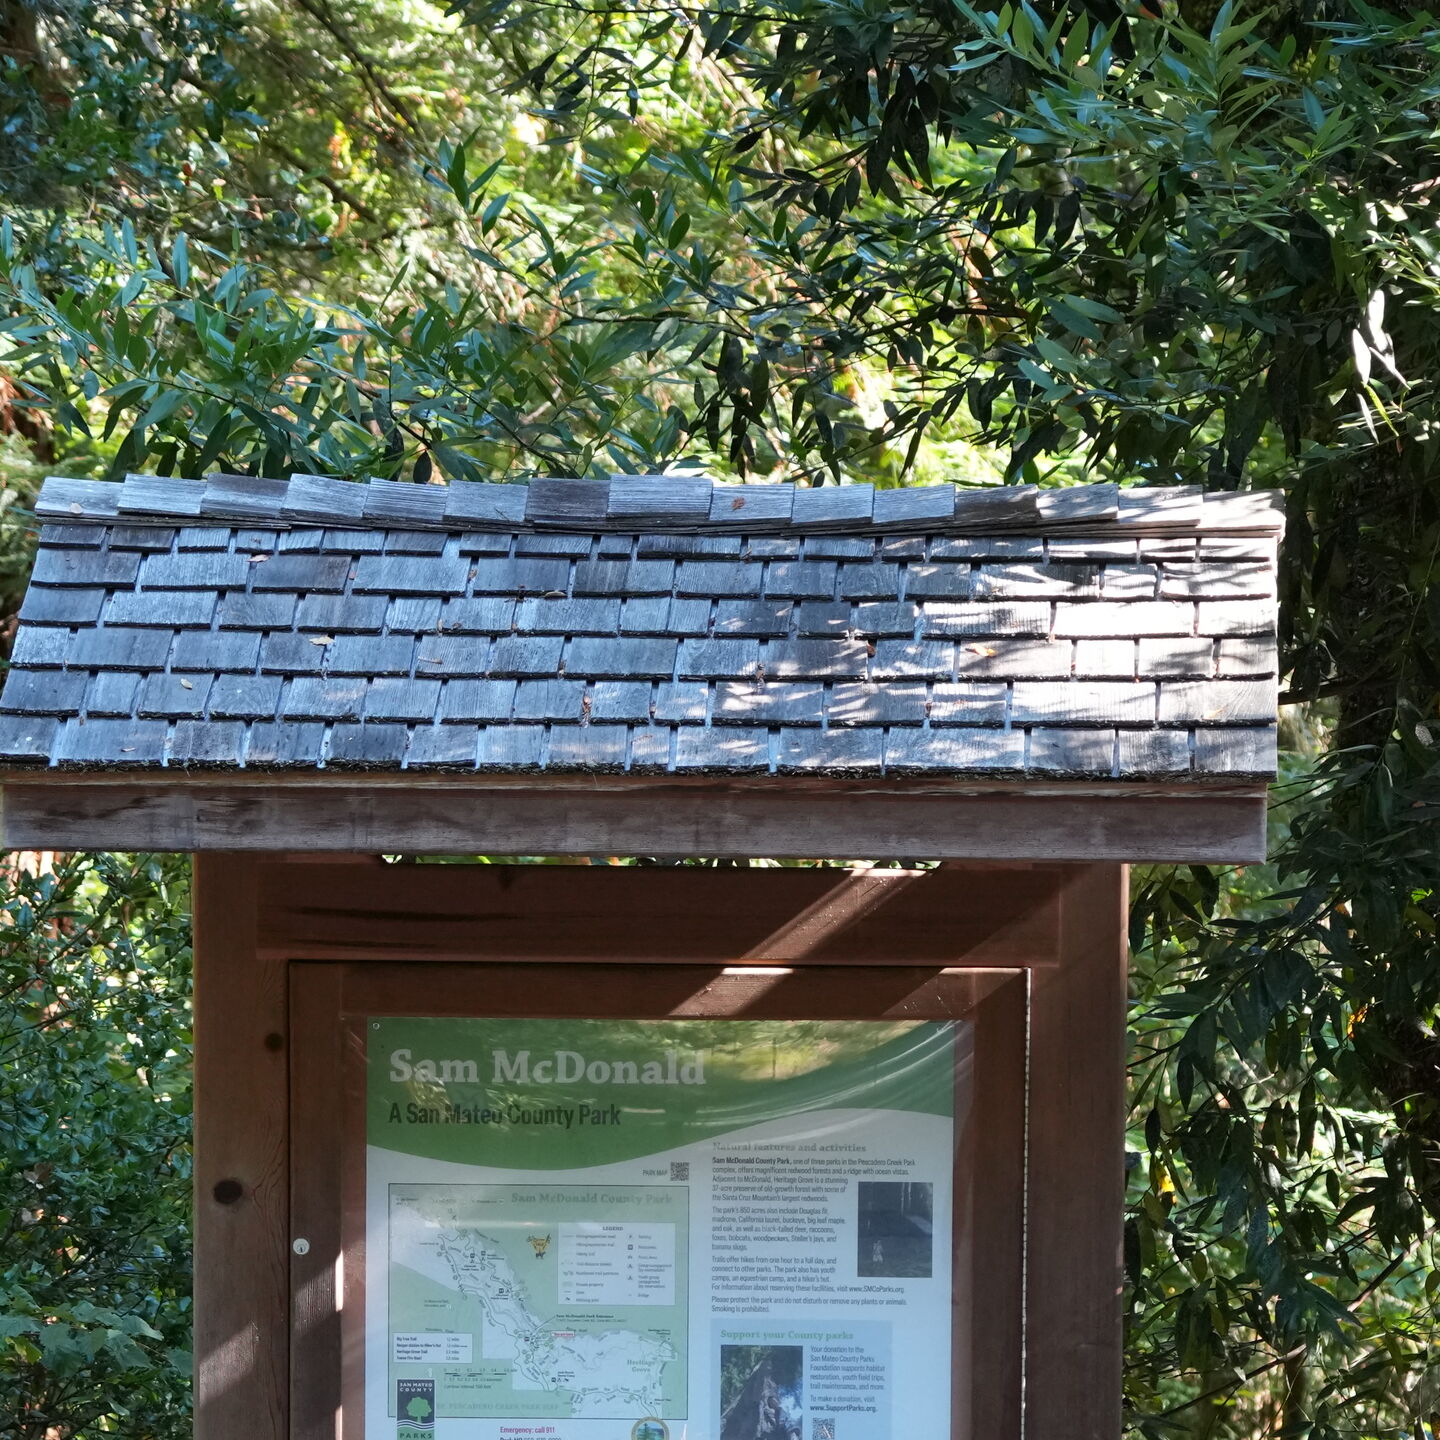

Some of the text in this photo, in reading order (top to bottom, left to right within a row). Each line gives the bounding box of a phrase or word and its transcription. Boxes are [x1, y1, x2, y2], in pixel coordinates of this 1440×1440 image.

[389, 1048, 707, 1085] Sam McDonald
[388, 1102, 621, 1130] A San Mateo County Park
[797, 1144, 818, 1152] and
[819, 1144, 867, 1152] activities
[712, 1156, 725, 1164] Sam
[755, 1157, 776, 1166] County
[825, 1158, 841, 1167] parks
[754, 1166, 787, 1175] magnificent
[847, 1167, 861, 1176] ridge
[712, 1175, 736, 1184] Adjacent
[773, 1176, 796, 1185] Heritage
[824, 1177, 848, 1185] stunning
[511, 1192, 536, 1204] Sam
[540, 1192, 598, 1204] McDonald
[601, 1193, 642, 1205] County
[645, 1193, 672, 1205] Park
[781, 1194, 800, 1203] largest
[798, 1207, 821, 1216] Douglas
[740, 1265, 755, 1273] other
[784, 1266, 797, 1275] park
[820, 1266, 836, 1275] youth
[739, 1275, 768, 1283] equestrian
[721, 1283, 752, 1291] information
[769, 1284, 795, 1293] reserving
[729, 1296, 750, 1305] protect
[760, 1296, 772, 1305] park
[860, 1297, 877, 1306] plants
[712, 1305, 735, 1314] Smoking
[720, 1329, 854, 1341] Support your County parks
[810, 1345, 823, 1353] Your
[838, 1355, 859, 1364] County
[841, 1364, 865, 1373] supports
[841, 1373, 857, 1382] youth
[858, 1373, 870, 1381] field
[863, 1395, 875, 1403] visit
[500, 1426, 534, 1435] Emergency:
